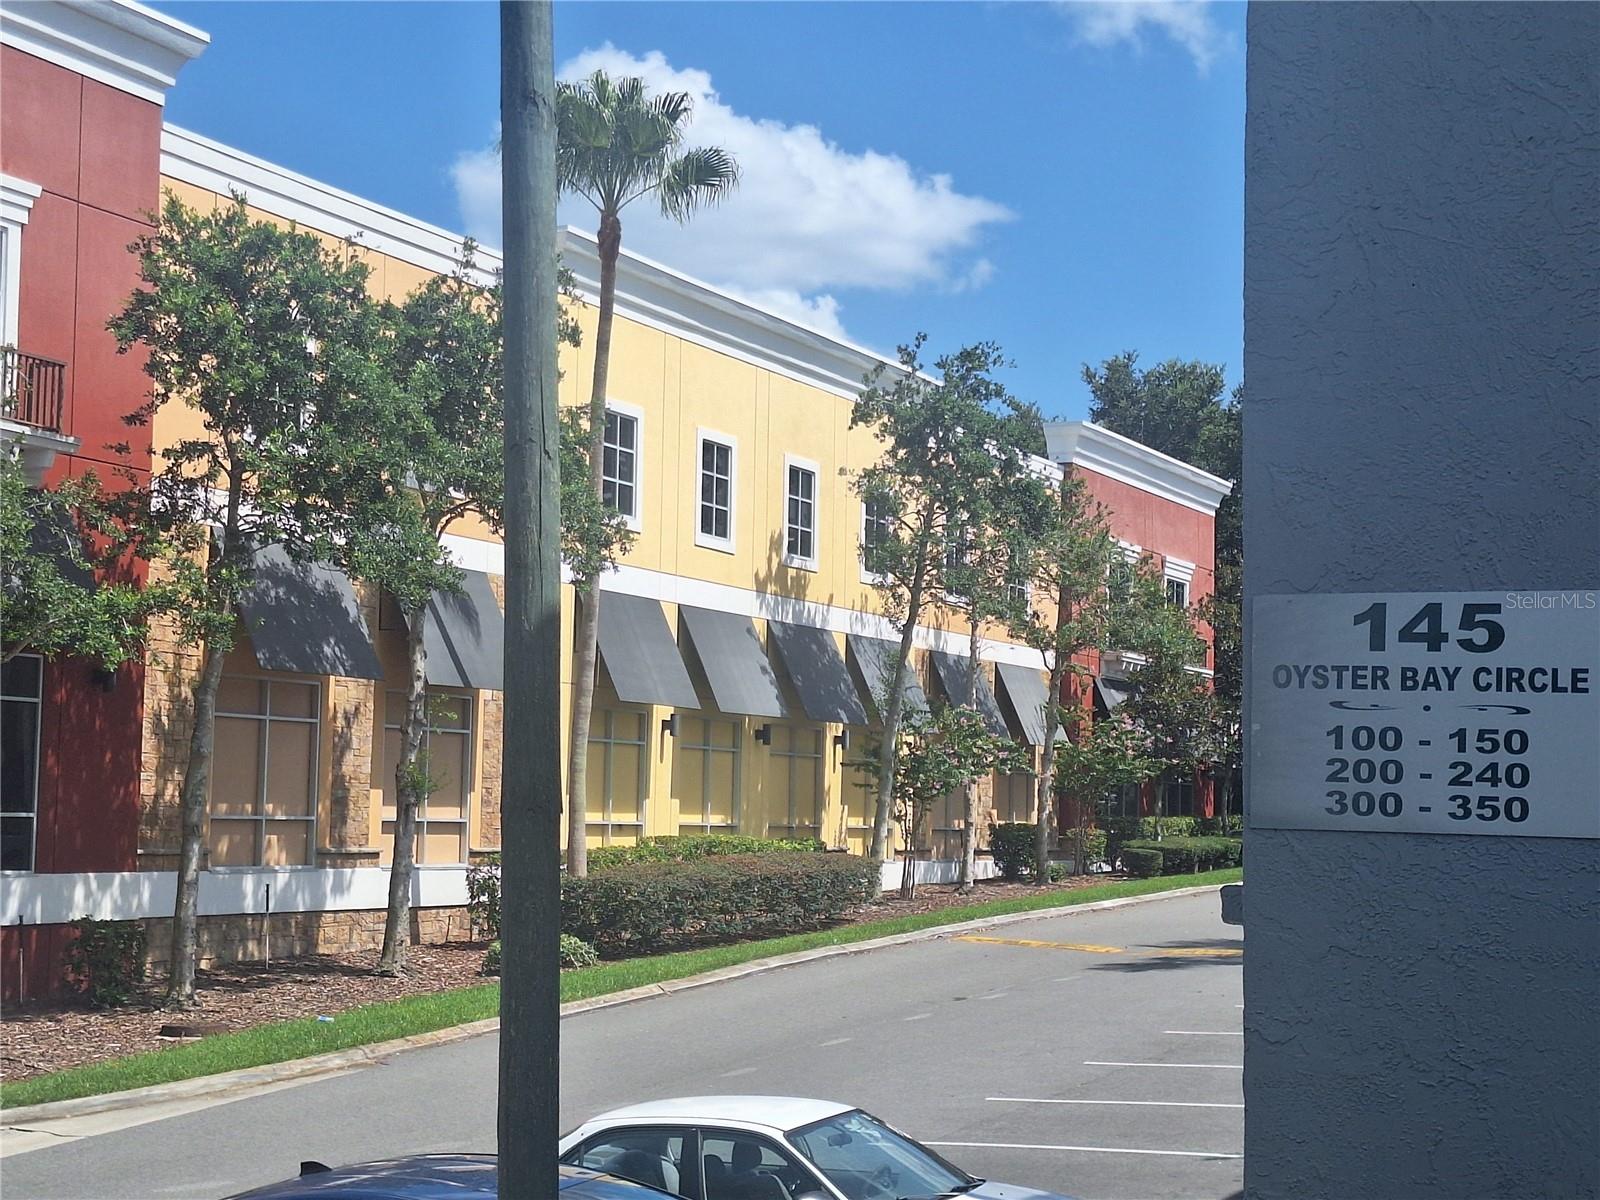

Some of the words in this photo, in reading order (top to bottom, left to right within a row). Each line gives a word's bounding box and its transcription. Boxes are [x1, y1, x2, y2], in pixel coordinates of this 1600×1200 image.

[1353, 602, 1506, 654] 145
[1272, 664, 1390, 690] OYSTER
[1400, 667, 1463, 691] BAY
[1472, 667, 1590, 694] CIRCLE
[1326, 725, 1403, 751] 100
[1448, 728, 1530, 755] 150
[1325, 758, 1404, 784] 200
[1447, 761, 1531, 789] 240
[1324, 790, 1403, 817] 300
[1447, 795, 1530, 823] 350
